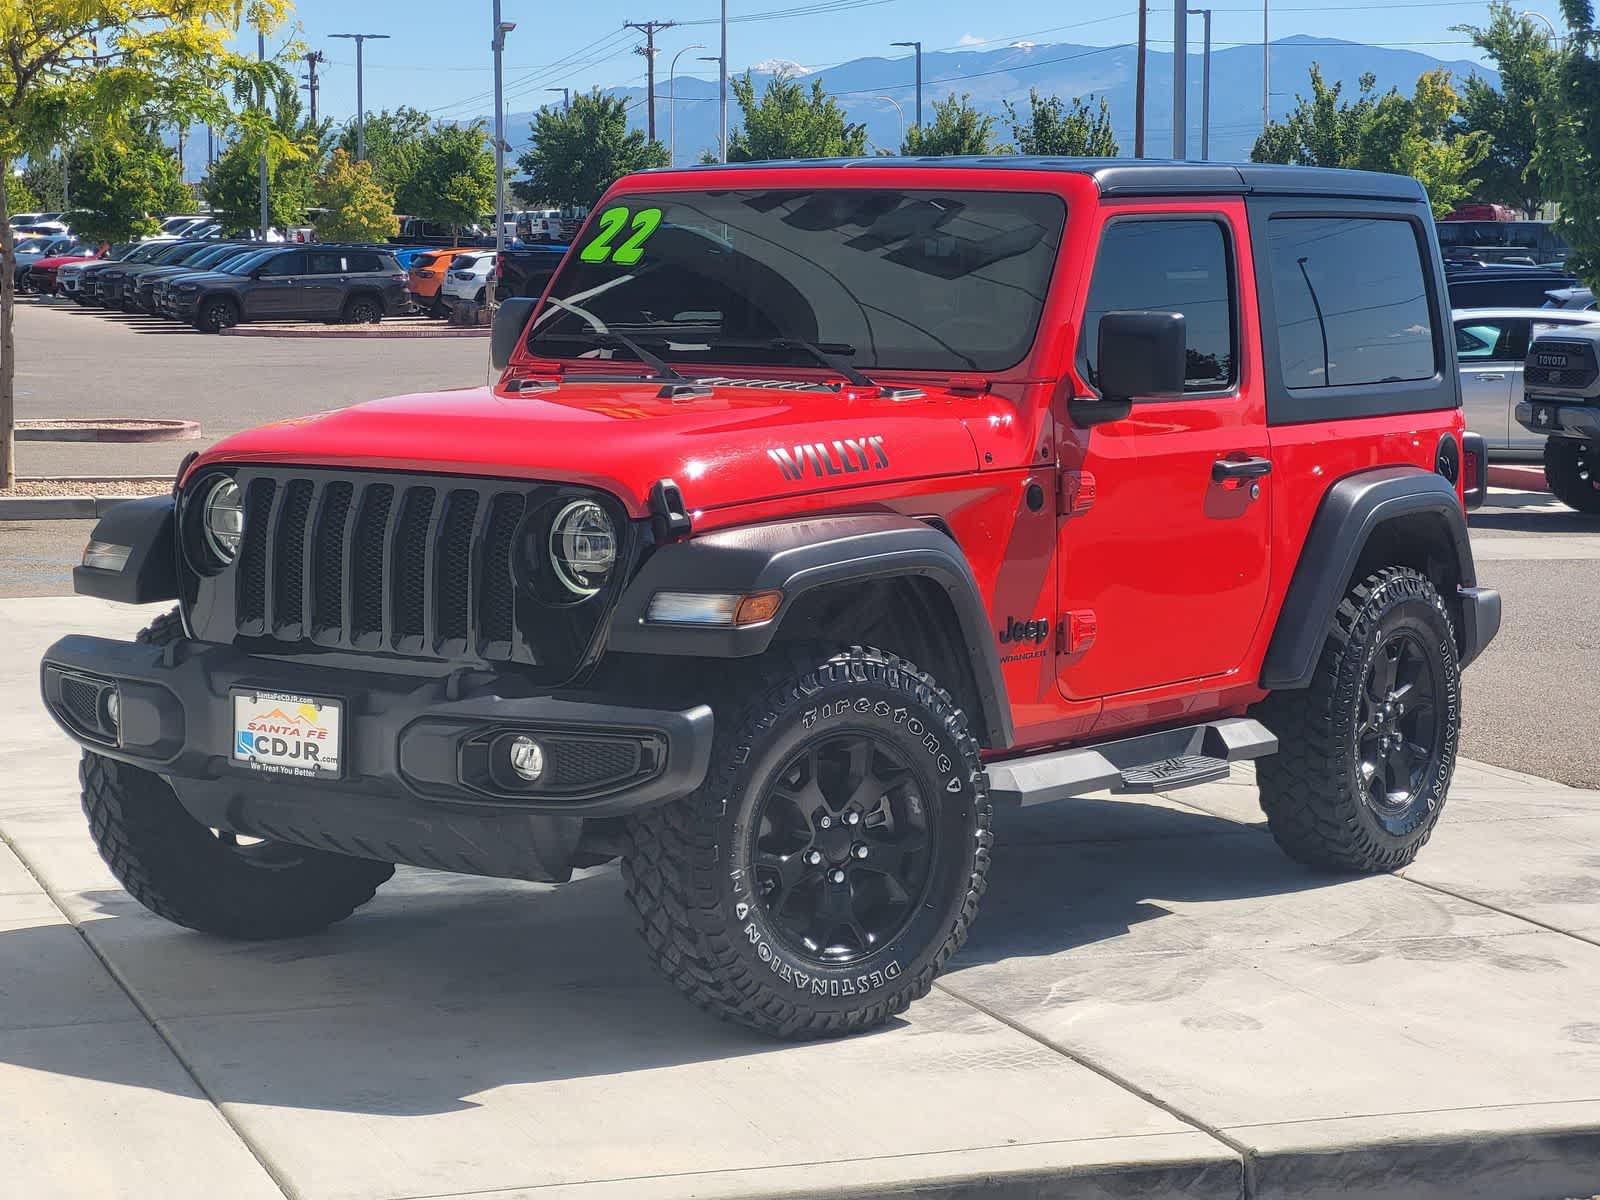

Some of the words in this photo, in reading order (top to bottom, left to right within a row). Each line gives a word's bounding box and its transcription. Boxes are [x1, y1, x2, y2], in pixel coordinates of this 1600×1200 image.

[580, 207, 662, 266] 22
[1539, 355, 1567, 366] TOYOTA
[766, 435, 889, 481] WILLYS
[999, 615, 1049, 645] Jeep
[247, 722, 301, 737] SANTA
[306, 729, 329, 740] FE
[802, 697, 952, 774] Firestone
[1433, 640, 1456, 798] DESTINATION
[254, 735, 320, 762] CDJR
[250, 761, 261, 770] We
[262, 763, 280, 774] Treat
[280, 766, 293, 775] You
[294, 767, 316, 777] Better
[744, 921, 903, 997] DESTINATION
